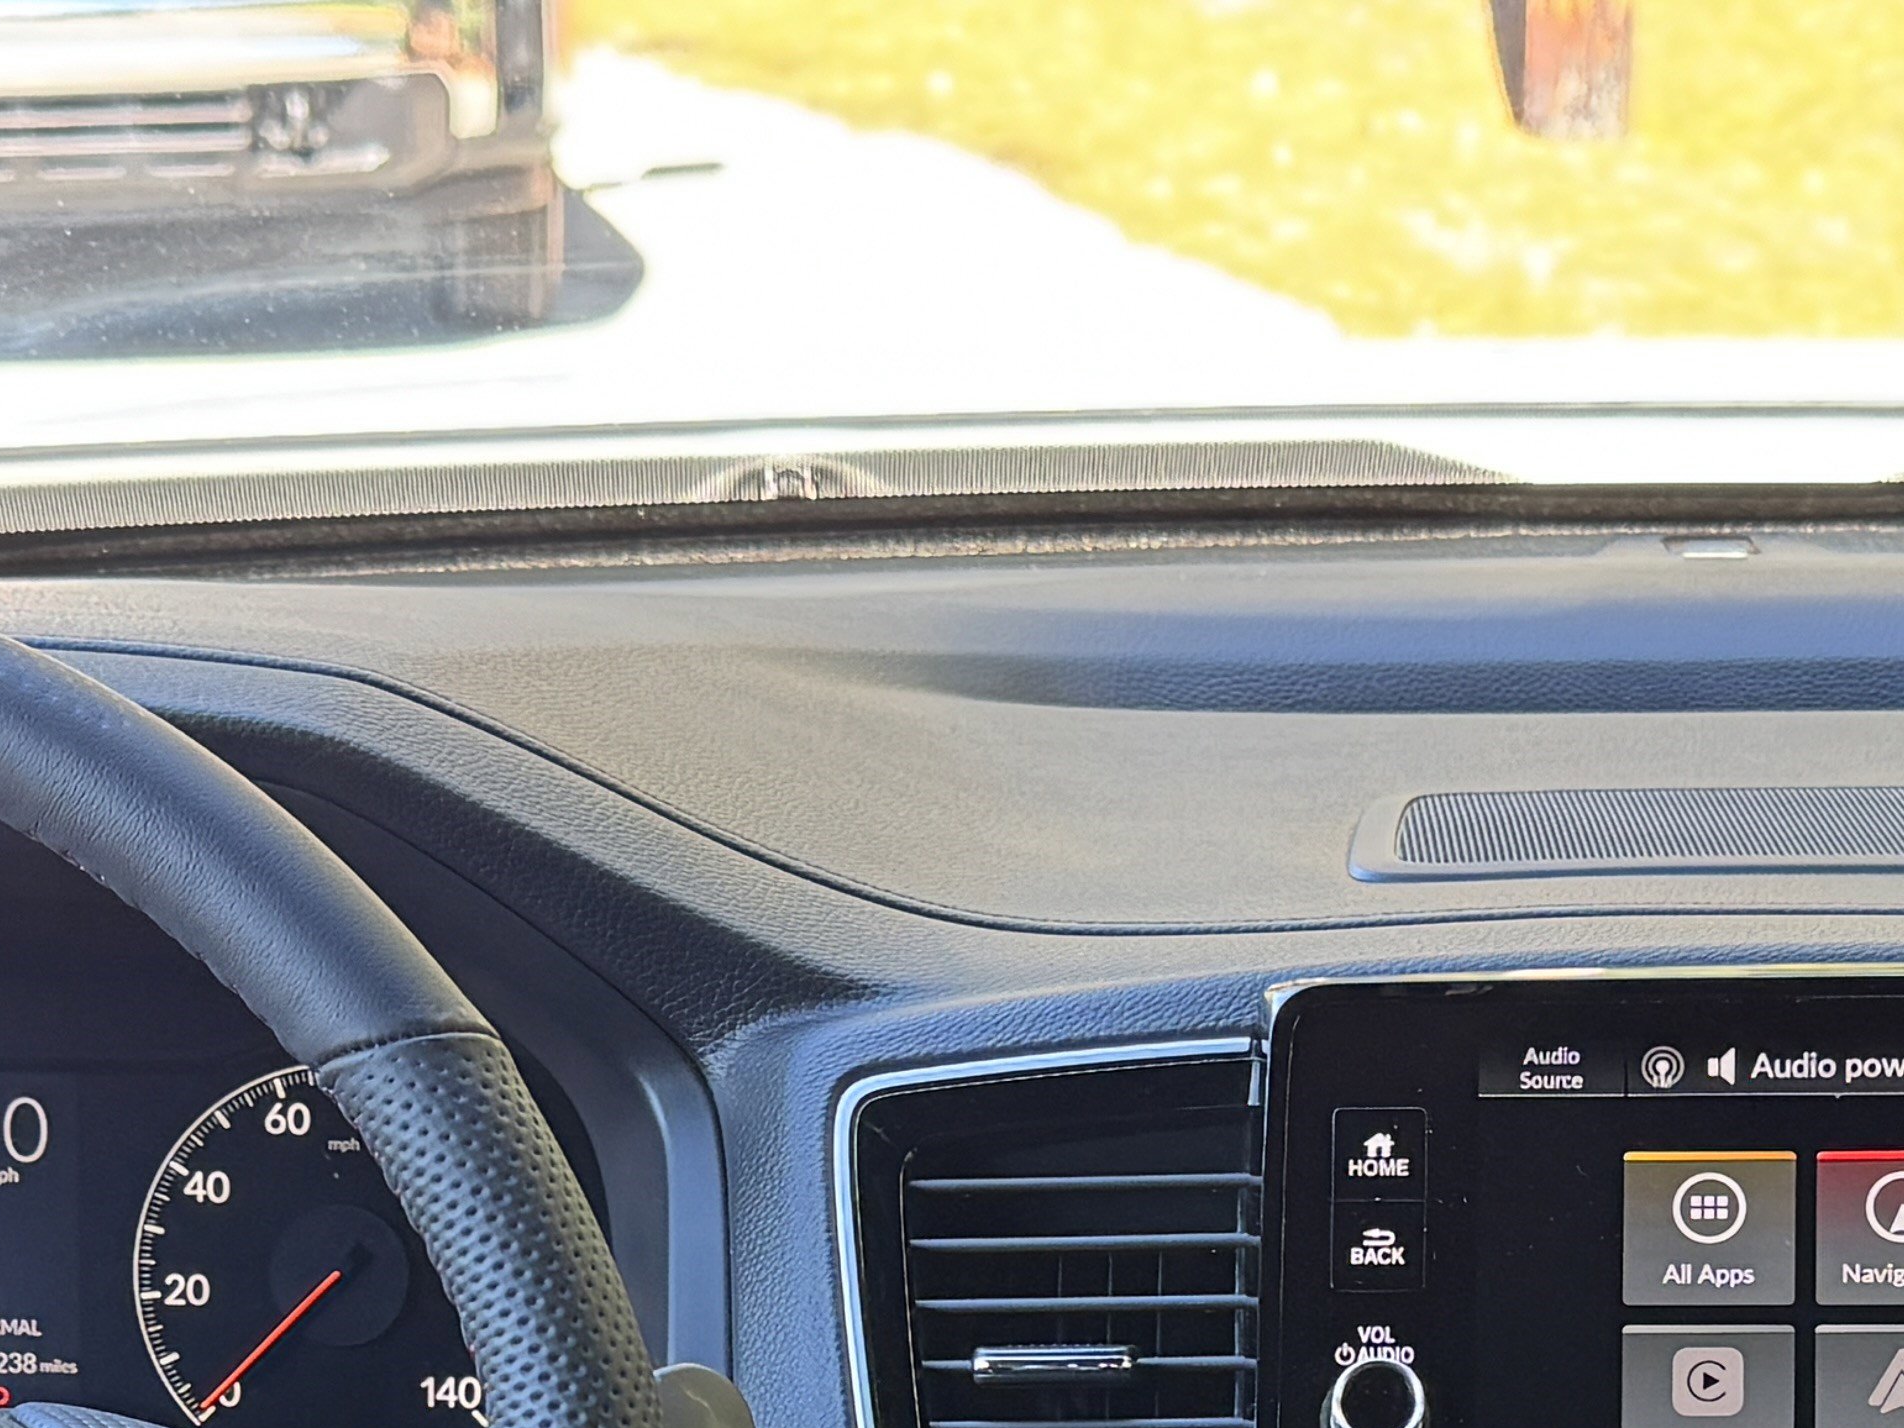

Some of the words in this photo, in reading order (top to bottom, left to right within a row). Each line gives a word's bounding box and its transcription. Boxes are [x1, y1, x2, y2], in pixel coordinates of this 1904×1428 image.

[1523, 1047, 1580, 1065] Audio
[1751, 1052, 1829, 1078] Audio
[1520, 1072, 1583, 1089] Source
[264, 1102, 312, 1136] 60
[3, 1097, 47, 1162] 0
[328, 1136, 360, 1154] mph
[1349, 1159, 1409, 1176] HOME
[183, 1169, 230, 1203] 40
[1351, 1247, 1405, 1265] BACK
[1663, 1264, 1691, 1284] All
[1698, 1264, 1755, 1287] Apps
[164, 1273, 210, 1305] 20
[1357, 1326, 1395, 1344] VOL
[1357, 1347, 1415, 1364] AUDIO
[39, 1358, 77, 1376] miles
[419, 1376, 482, 1410] 140
